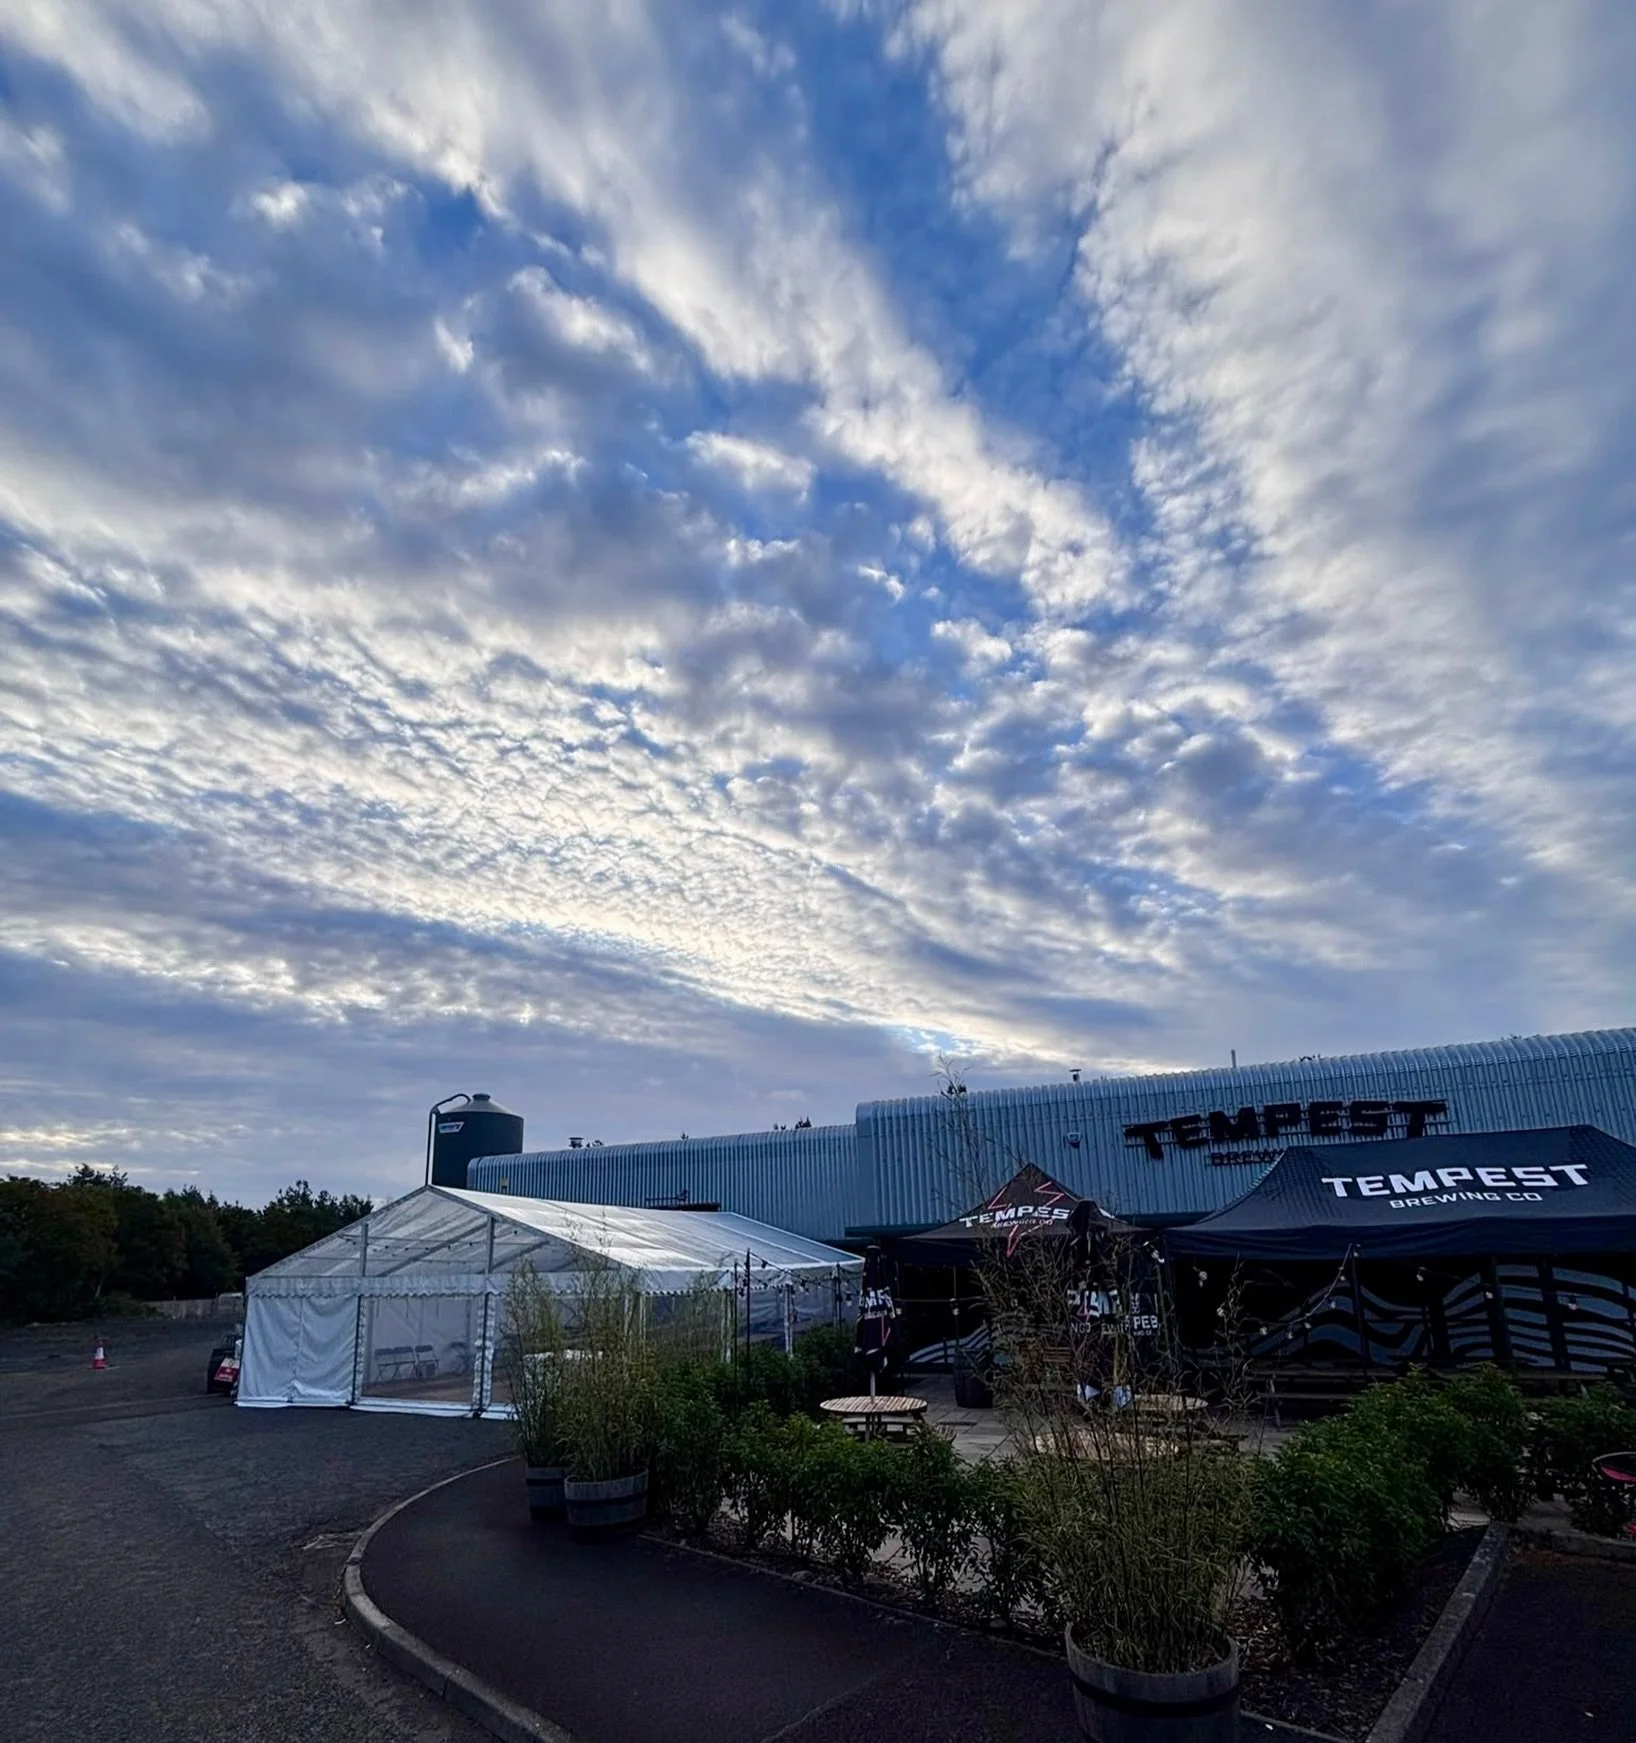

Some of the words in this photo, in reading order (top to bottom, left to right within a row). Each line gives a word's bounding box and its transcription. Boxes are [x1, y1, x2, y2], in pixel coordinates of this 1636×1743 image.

[1124, 1099, 1447, 1159] TEMPEST
[1321, 1163, 1589, 1198] TEMPEST
[1389, 1191, 1501, 1209] BREWING
[1506, 1192, 1544, 1202] CO
[959, 1205, 1073, 1228] TEMPES
